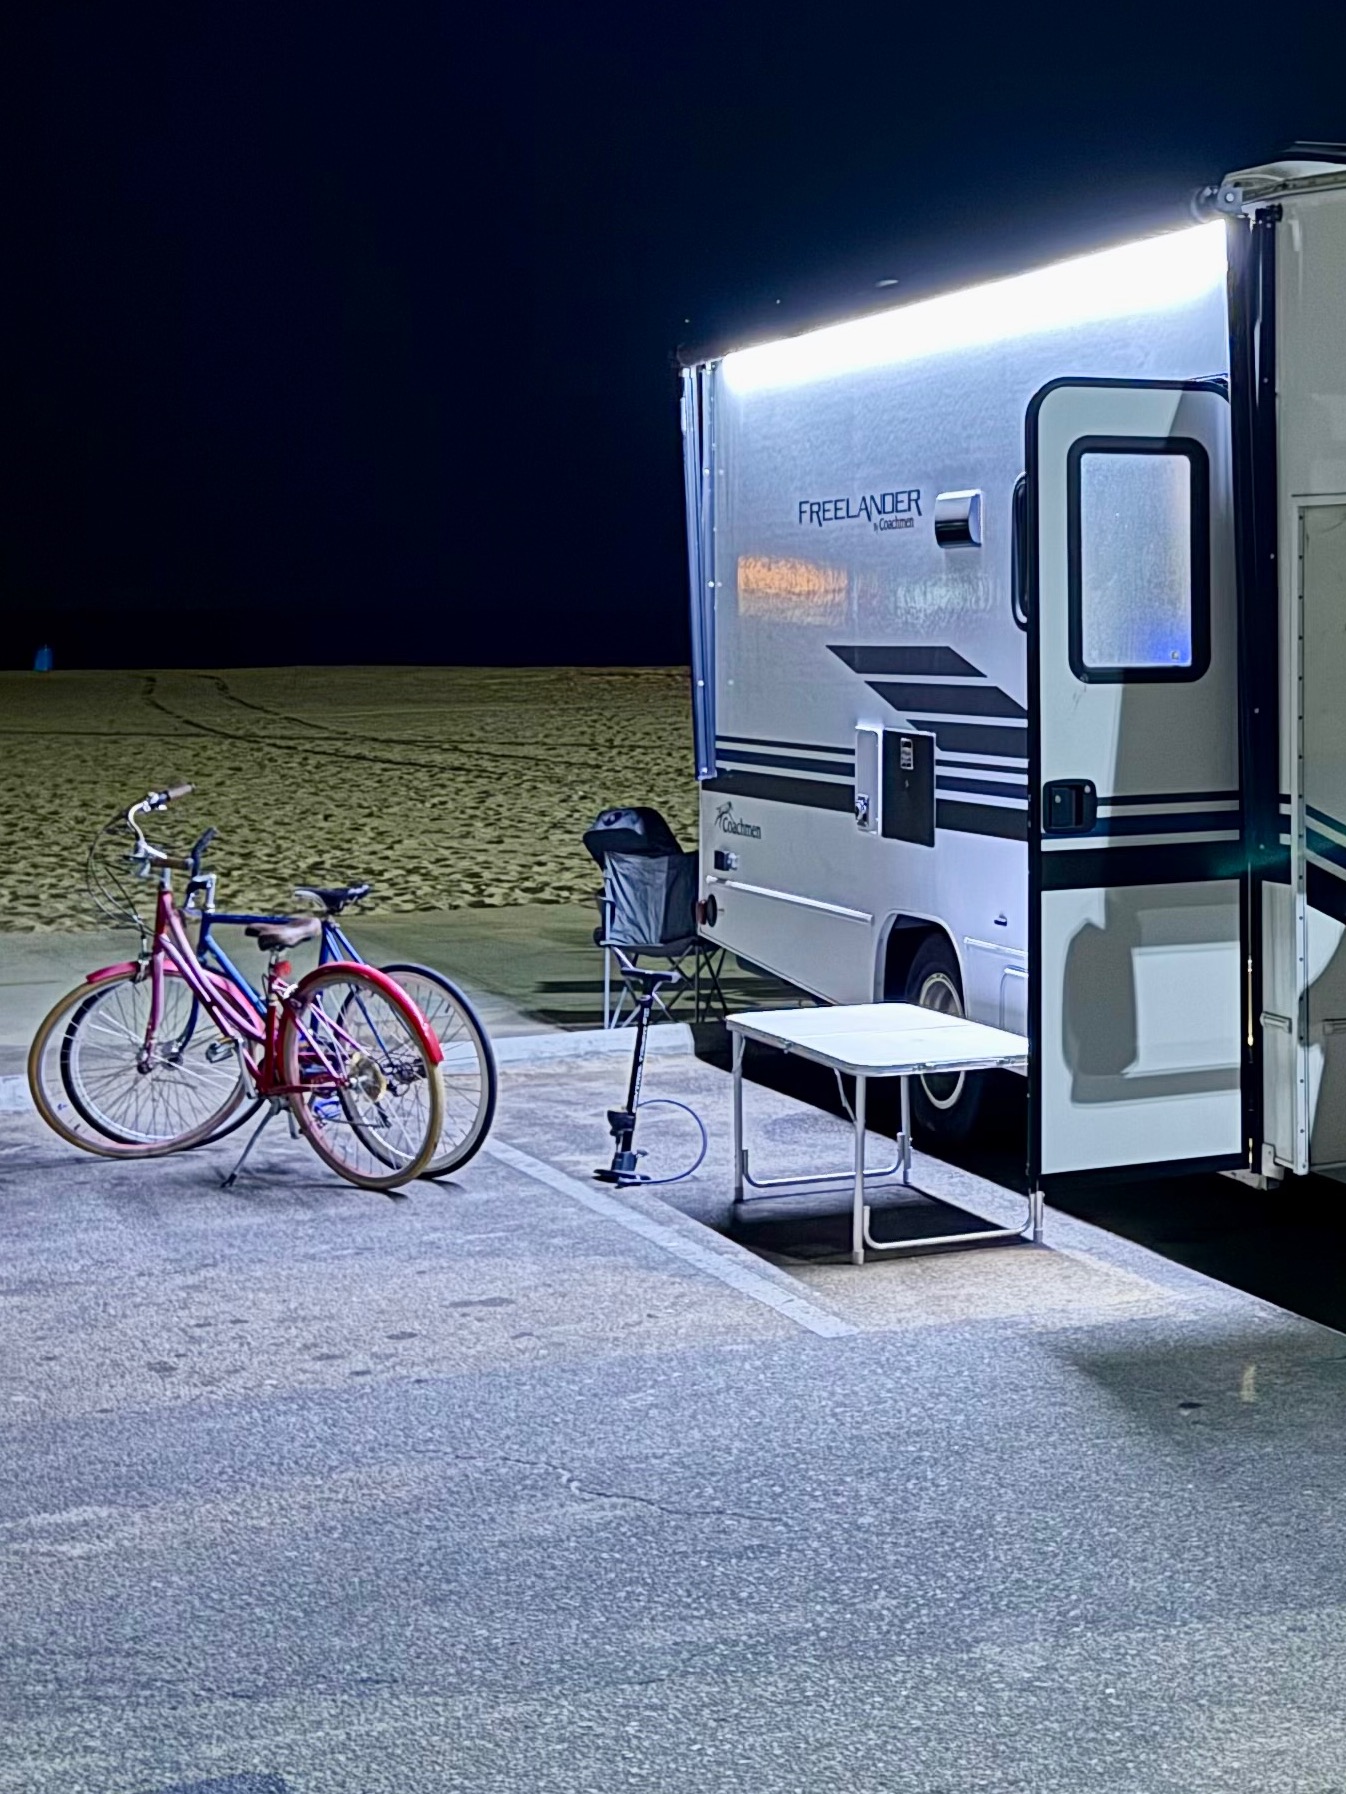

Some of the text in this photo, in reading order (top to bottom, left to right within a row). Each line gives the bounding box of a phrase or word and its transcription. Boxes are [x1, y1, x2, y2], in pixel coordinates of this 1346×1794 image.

[799, 489, 922, 527] FREELANDER
[879, 515, 914, 532] Coachmen
[722, 816, 762, 839] Coachmen
